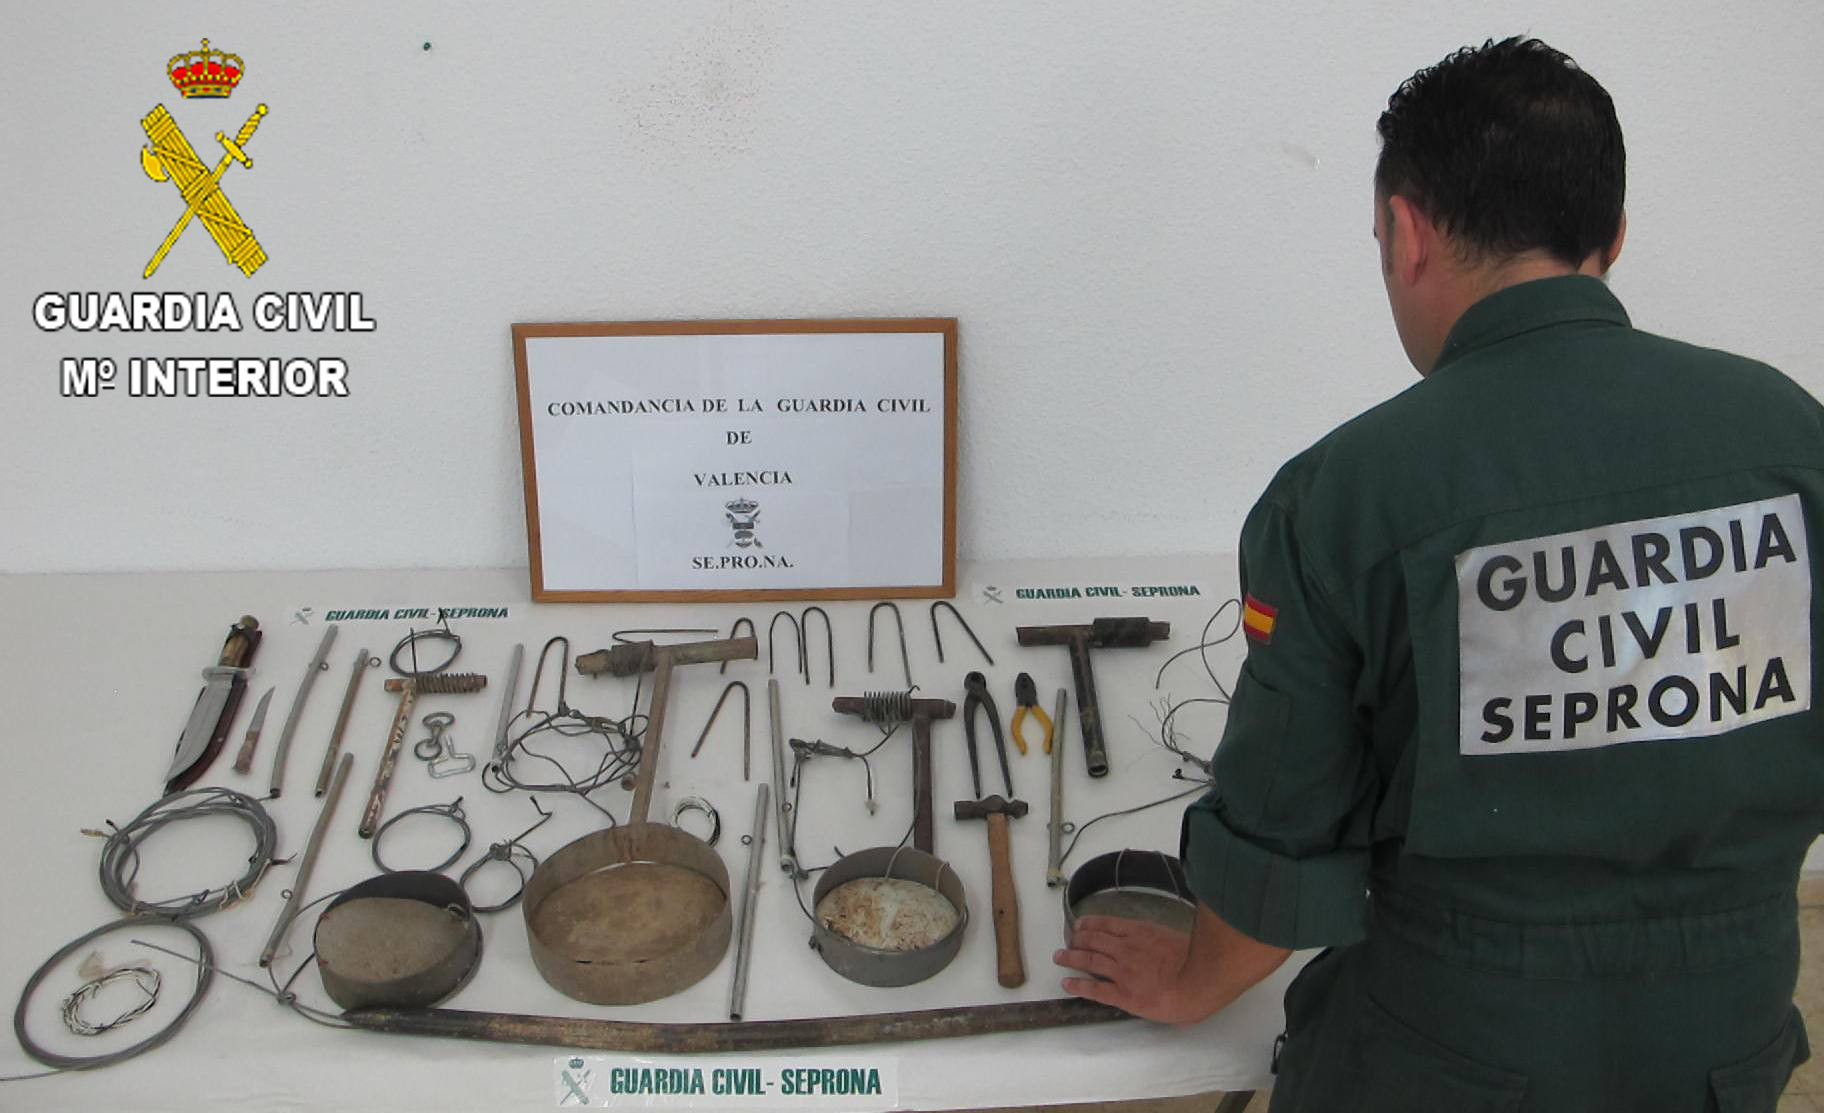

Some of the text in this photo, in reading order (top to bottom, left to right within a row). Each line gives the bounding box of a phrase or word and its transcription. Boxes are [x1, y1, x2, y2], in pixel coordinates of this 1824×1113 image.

[547, 397, 931, 418] COMANDANCIA DE LA GUARDIA CIVIL
[726, 431, 752, 446] DE
[694, 470, 793, 487] VALENCIA
[692, 556, 794, 571] SE.PRO.NA.
[1477, 513, 1797, 612] GUARDIA
[1015, 587, 1082, 600] GUARDIA
[1131, 585, 1201, 598] SEPRONA
[325, 608, 389, 622] GUARDIA
[440, 607, 509, 620] SEPRONA
[1550, 598, 1740, 674] CIVIL
[1480, 656, 1796, 744] SEPRONA
[610, 1067, 705, 1095] GUARDIA
[781, 1068, 882, 1095] SEPRONA
